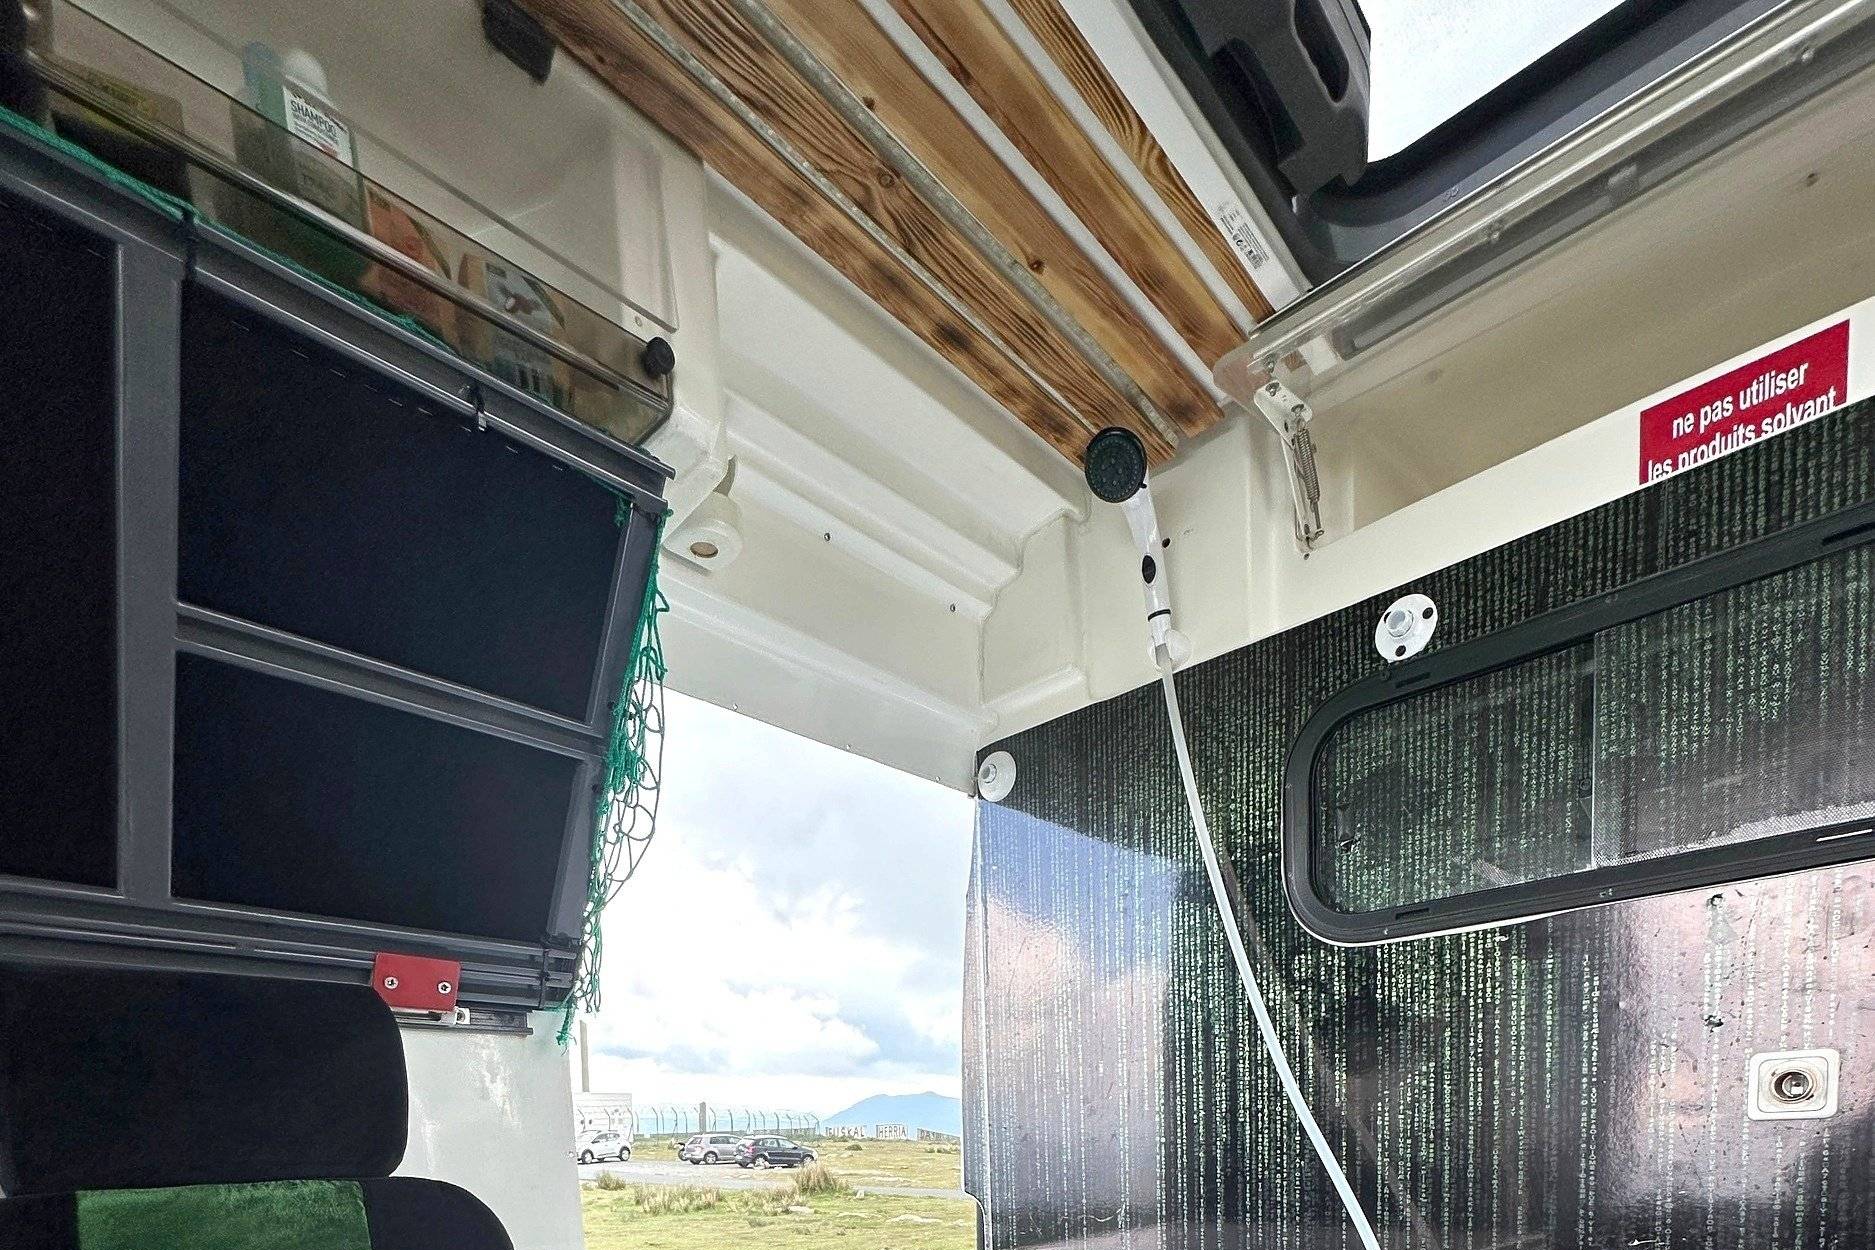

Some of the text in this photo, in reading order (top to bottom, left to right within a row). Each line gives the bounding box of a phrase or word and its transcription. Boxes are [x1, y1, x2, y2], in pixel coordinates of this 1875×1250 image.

[291, 99, 338, 138] SHAMPOO
[1672, 362, 1809, 440] ne pas utiliser
[1648, 385, 1837, 483] les produits solvant
[828, 1126, 865, 1138] EUSKAL
[878, 1125, 907, 1138] HERRIA
